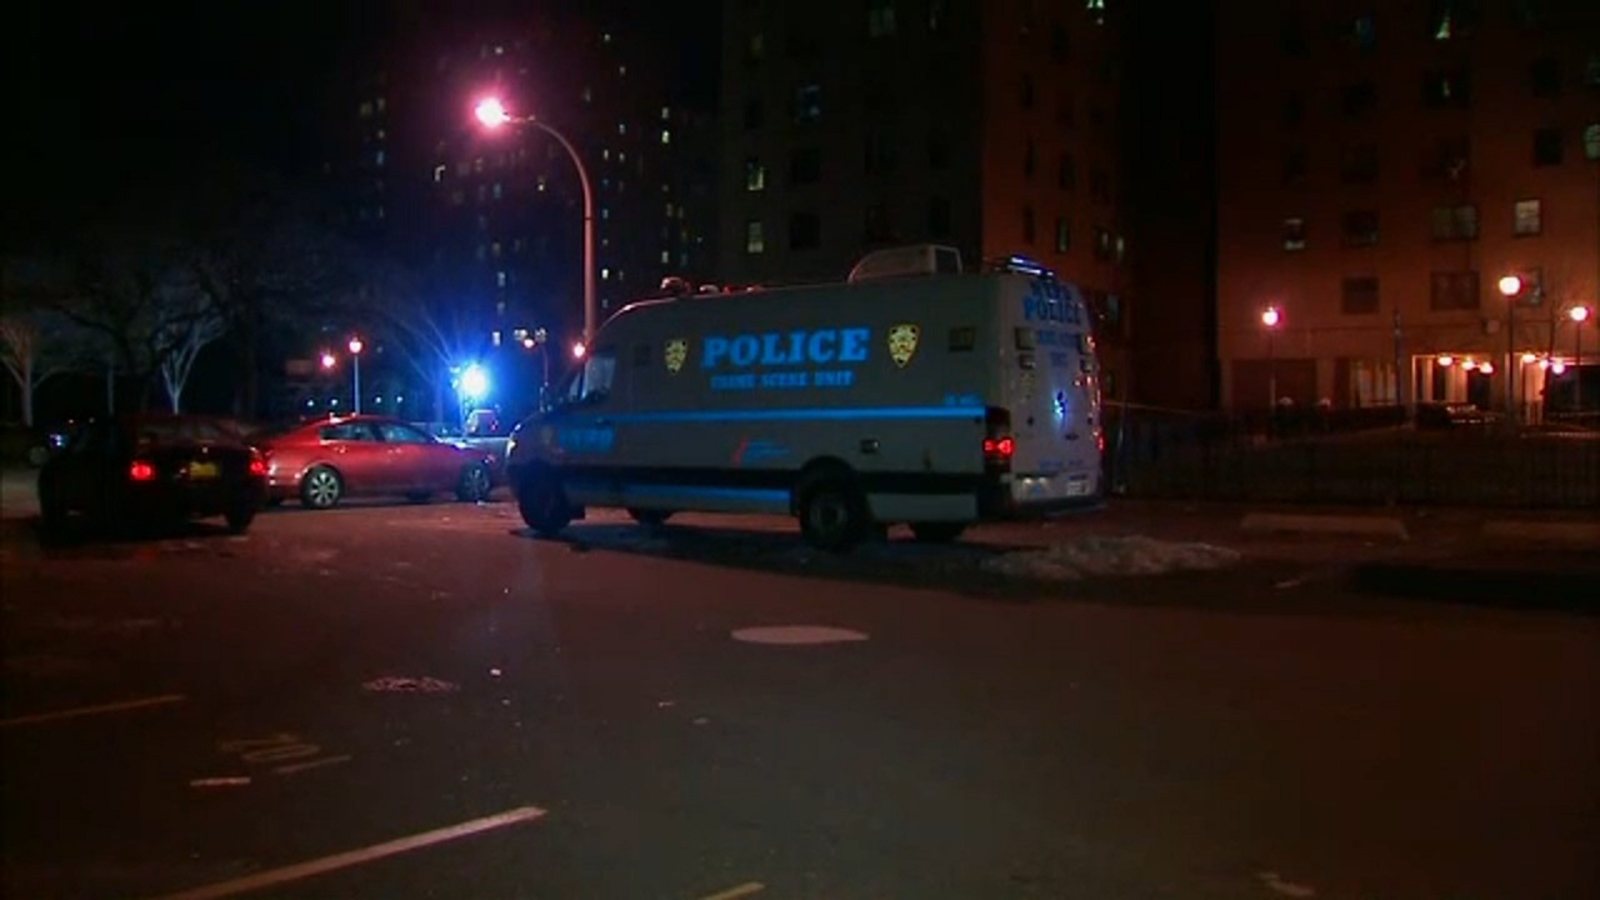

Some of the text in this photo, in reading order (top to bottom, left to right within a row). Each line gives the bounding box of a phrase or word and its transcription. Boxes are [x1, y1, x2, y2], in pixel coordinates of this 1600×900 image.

[1024, 297, 1080, 325] POLICE
[702, 328, 869, 370] POLICE
[760, 371, 809, 388] SCENE
[814, 369, 856, 386] UNIT
